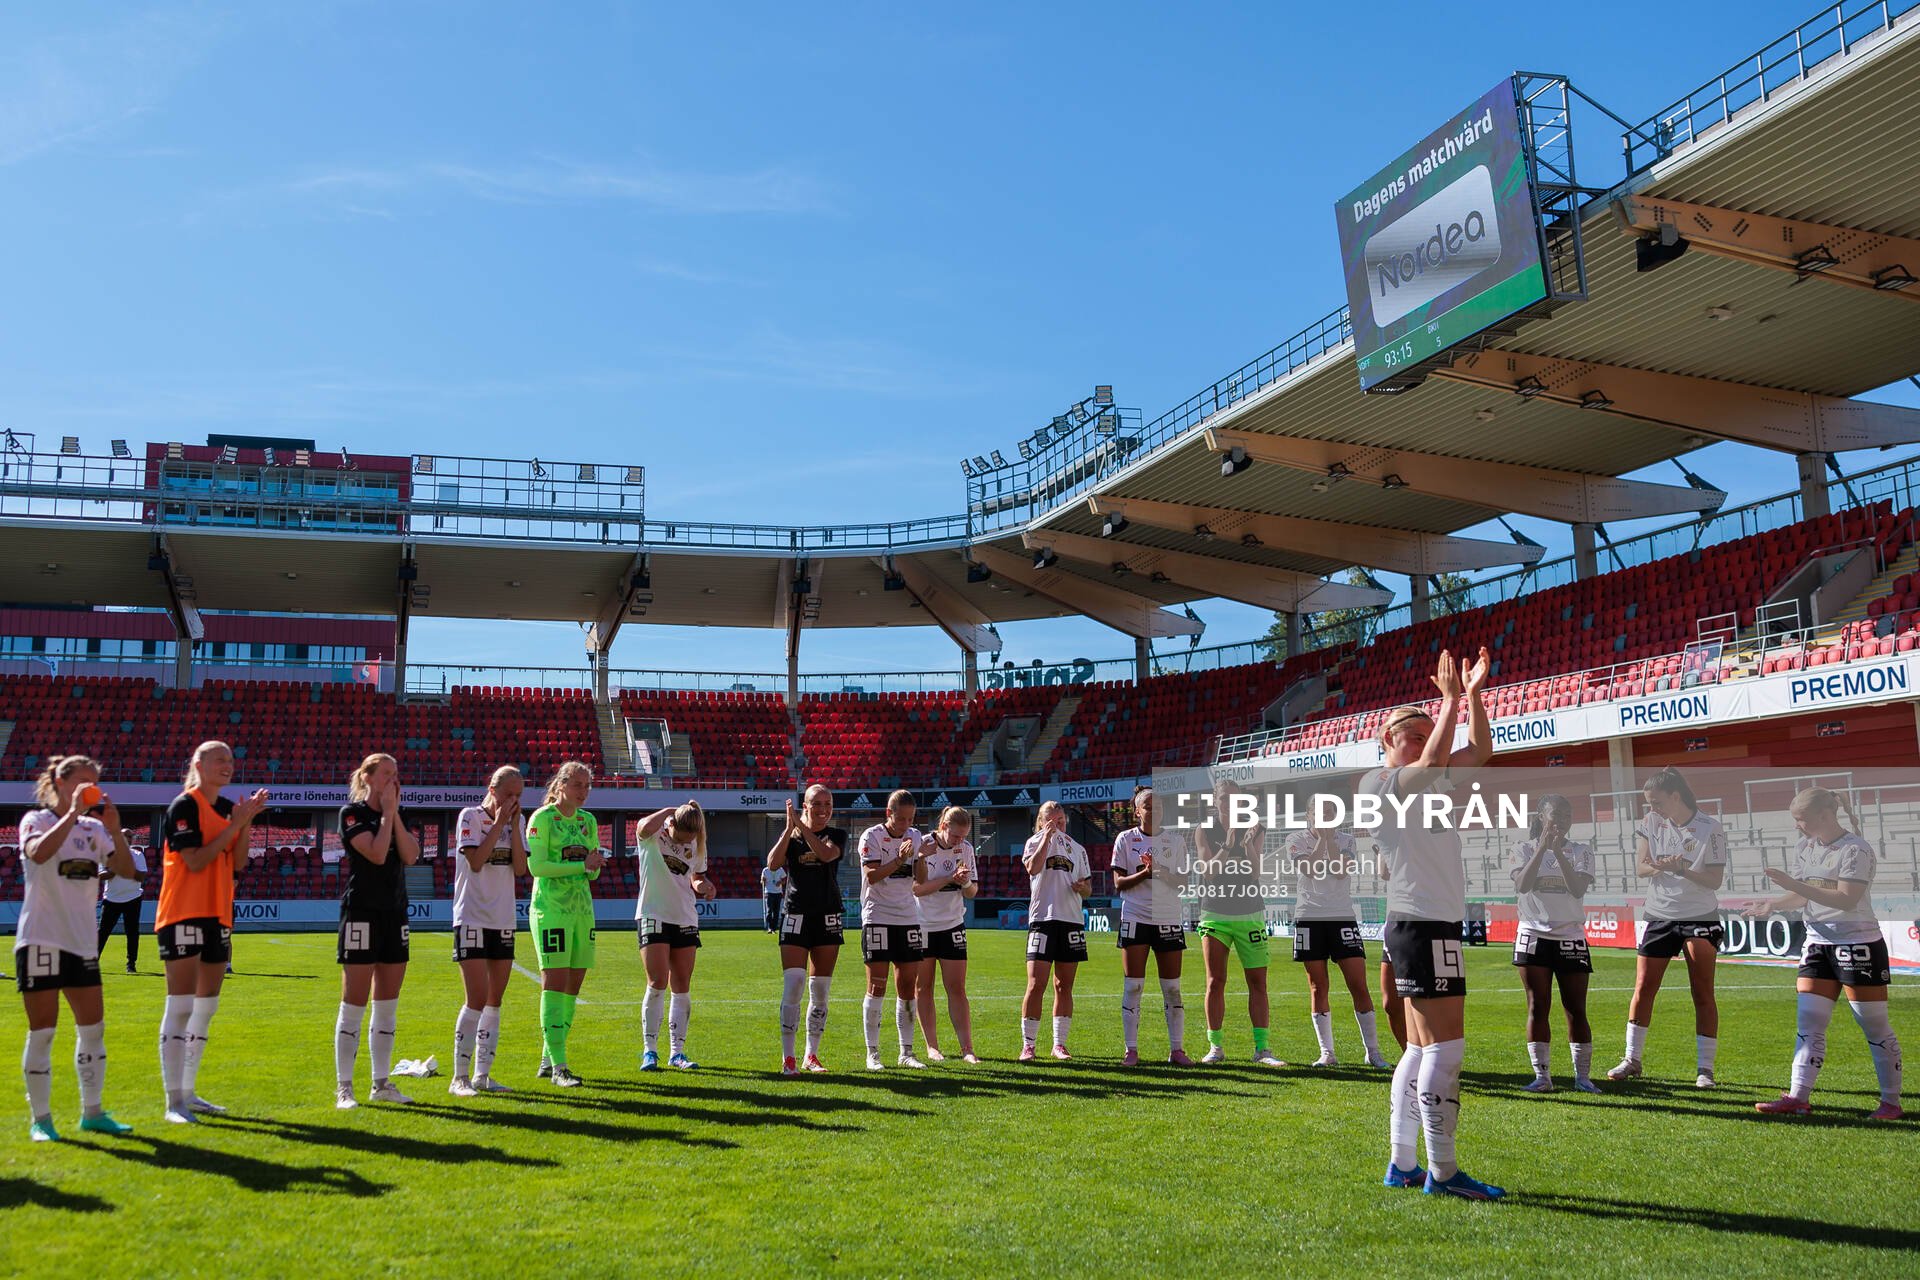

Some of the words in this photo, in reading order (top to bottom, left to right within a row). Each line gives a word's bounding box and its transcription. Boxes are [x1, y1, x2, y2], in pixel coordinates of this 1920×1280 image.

[1353, 173, 1406, 224] Dagens
[1408, 108, 1494, 187] matchvärd
[1376, 210, 1486, 297] Nordea
[1384, 341, 1413, 368] 93:15
[1792, 664, 1906, 703] PREMON
[1620, 694, 1709, 727] PREMON
[1289, 752, 1336, 773] PREMON
[740, 794, 767, 806] Spiris
[1061, 784, 1113, 801] PREMON
[1721, 913, 1791, 955] DLO
[1435, 978, 1449, 991] 22
